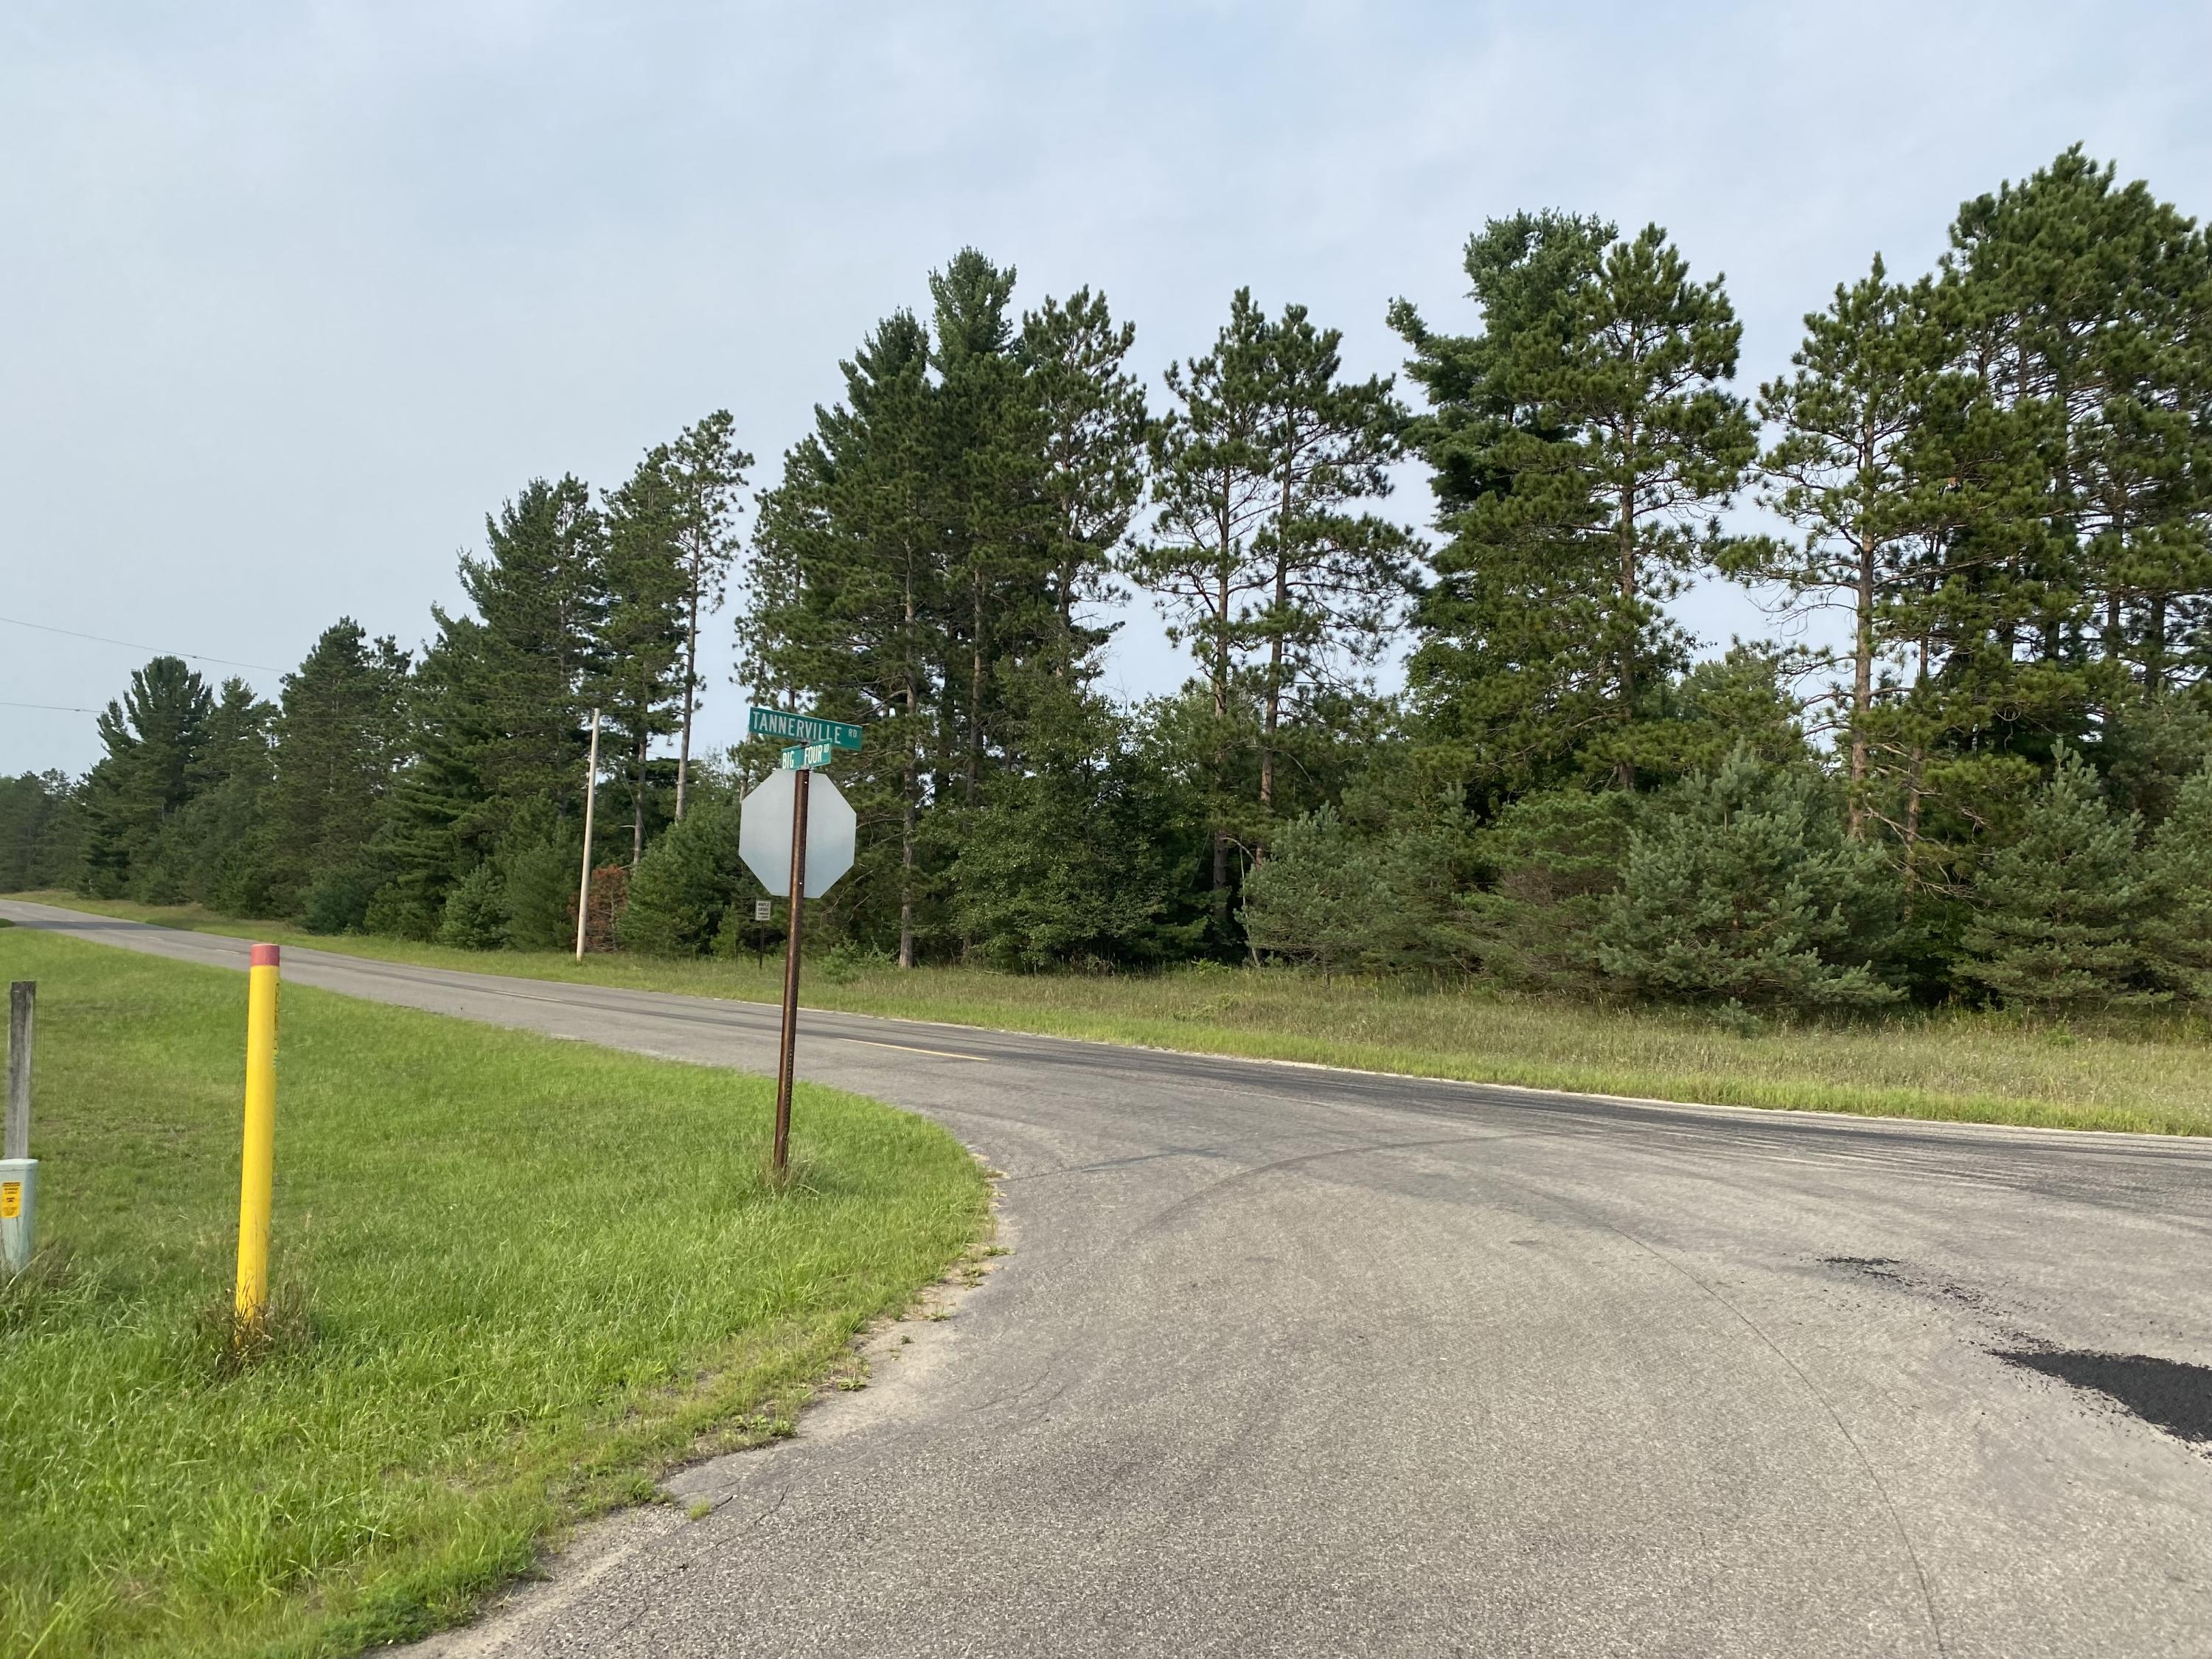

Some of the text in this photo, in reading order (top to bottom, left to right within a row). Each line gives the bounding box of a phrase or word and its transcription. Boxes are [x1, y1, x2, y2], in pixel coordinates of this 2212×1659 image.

[752, 711, 858, 744] TANNERVILLE RD
[782, 742, 830, 769] BIG FOUR RD
